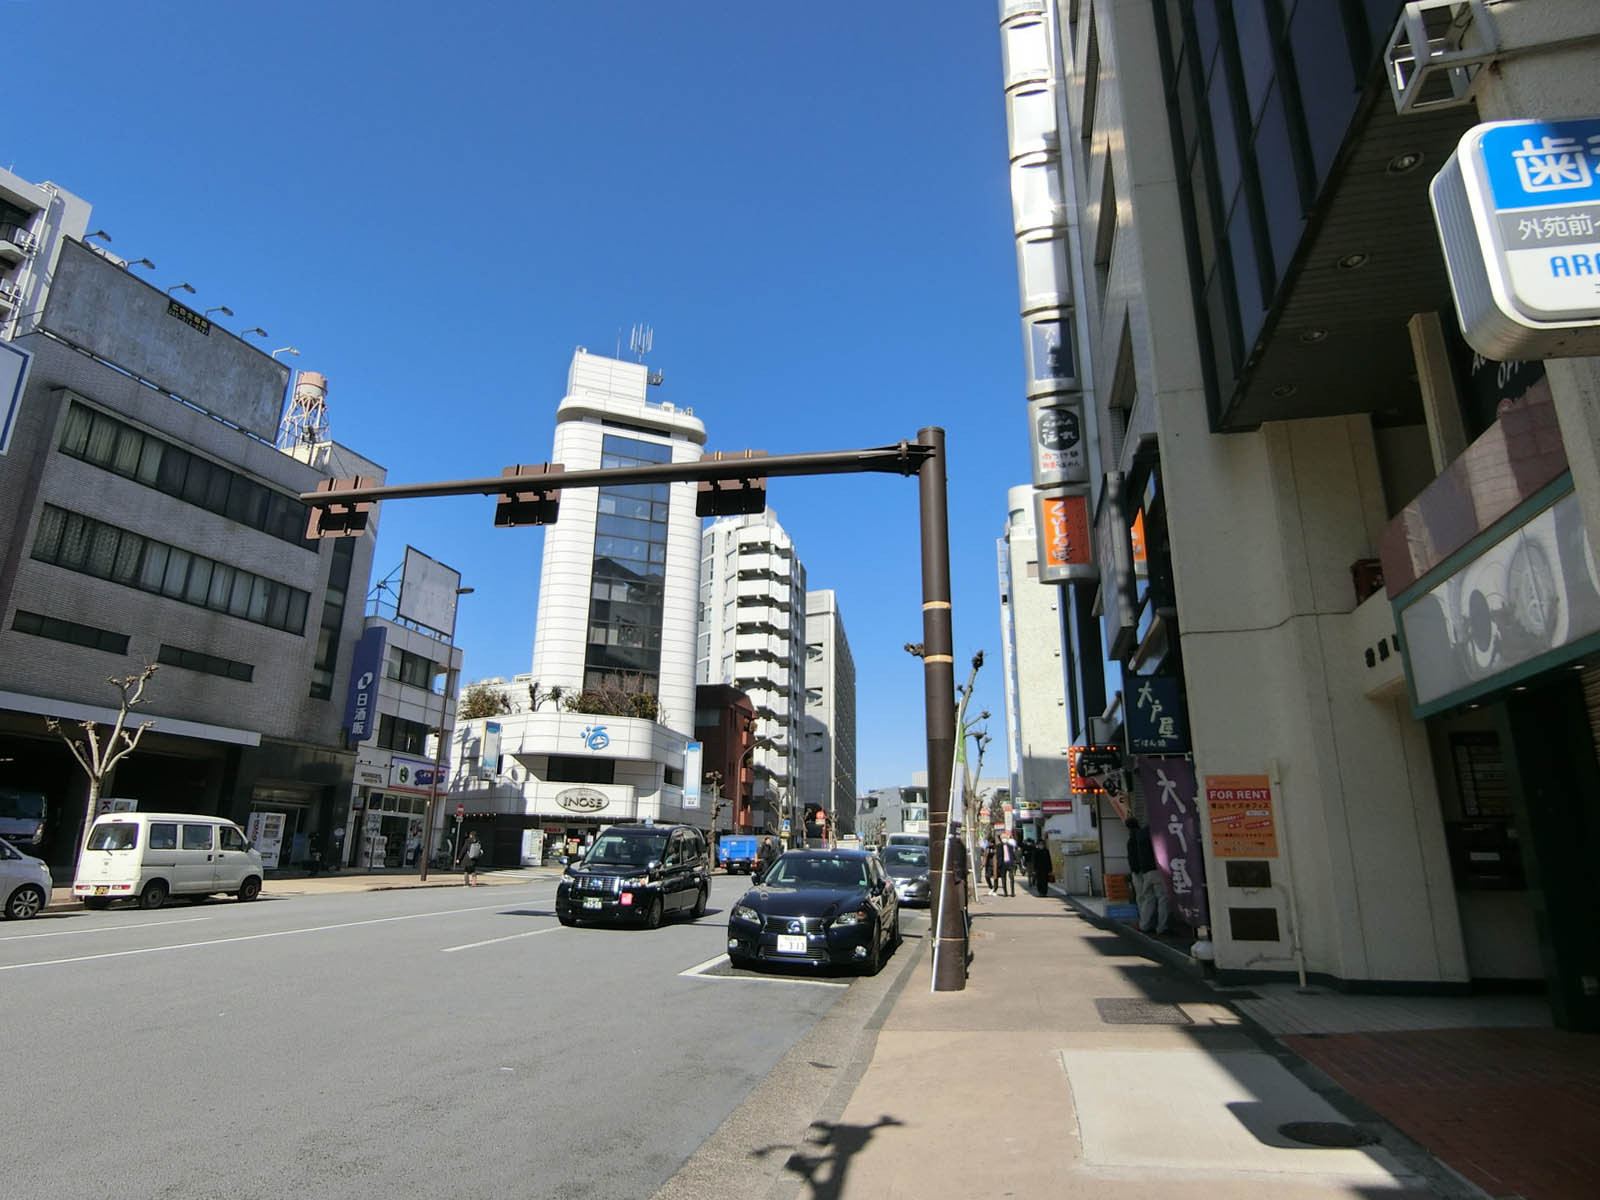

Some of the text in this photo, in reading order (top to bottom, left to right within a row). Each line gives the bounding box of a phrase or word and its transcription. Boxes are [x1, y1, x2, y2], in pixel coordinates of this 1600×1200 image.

[351, 693, 368, 735] 日酒販
[1137, 680, 1179, 739] 大戸屋
[563, 796, 603, 808] INOSE
[1210, 790, 1268, 800] FOR RENT
